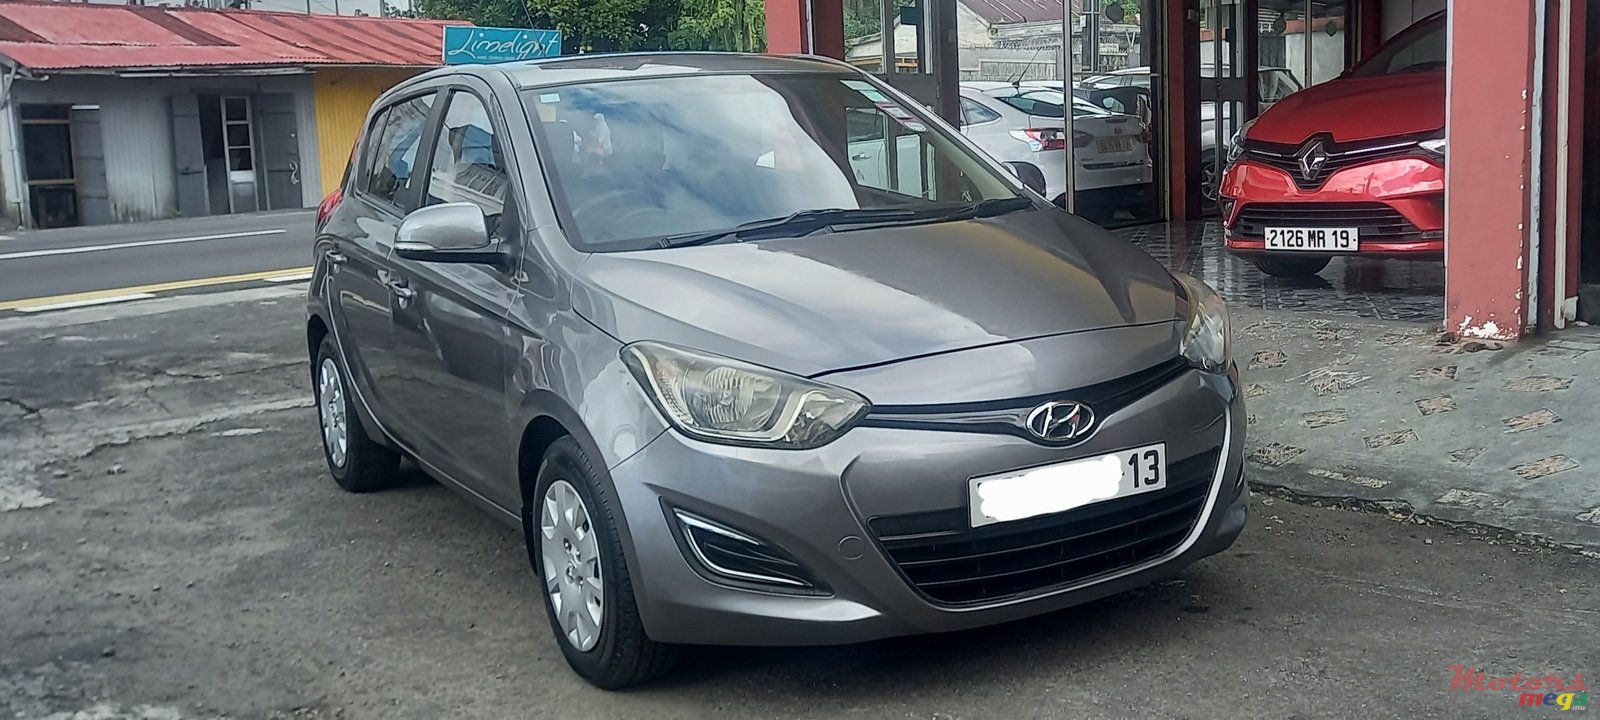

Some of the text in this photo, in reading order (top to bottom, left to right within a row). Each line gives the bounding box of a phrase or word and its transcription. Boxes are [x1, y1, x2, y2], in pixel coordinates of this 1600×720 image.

[448, 30, 559, 60] Limelight
[1270, 229, 1349, 248] 2126 MR 19
[1128, 450, 1159, 488] 13
